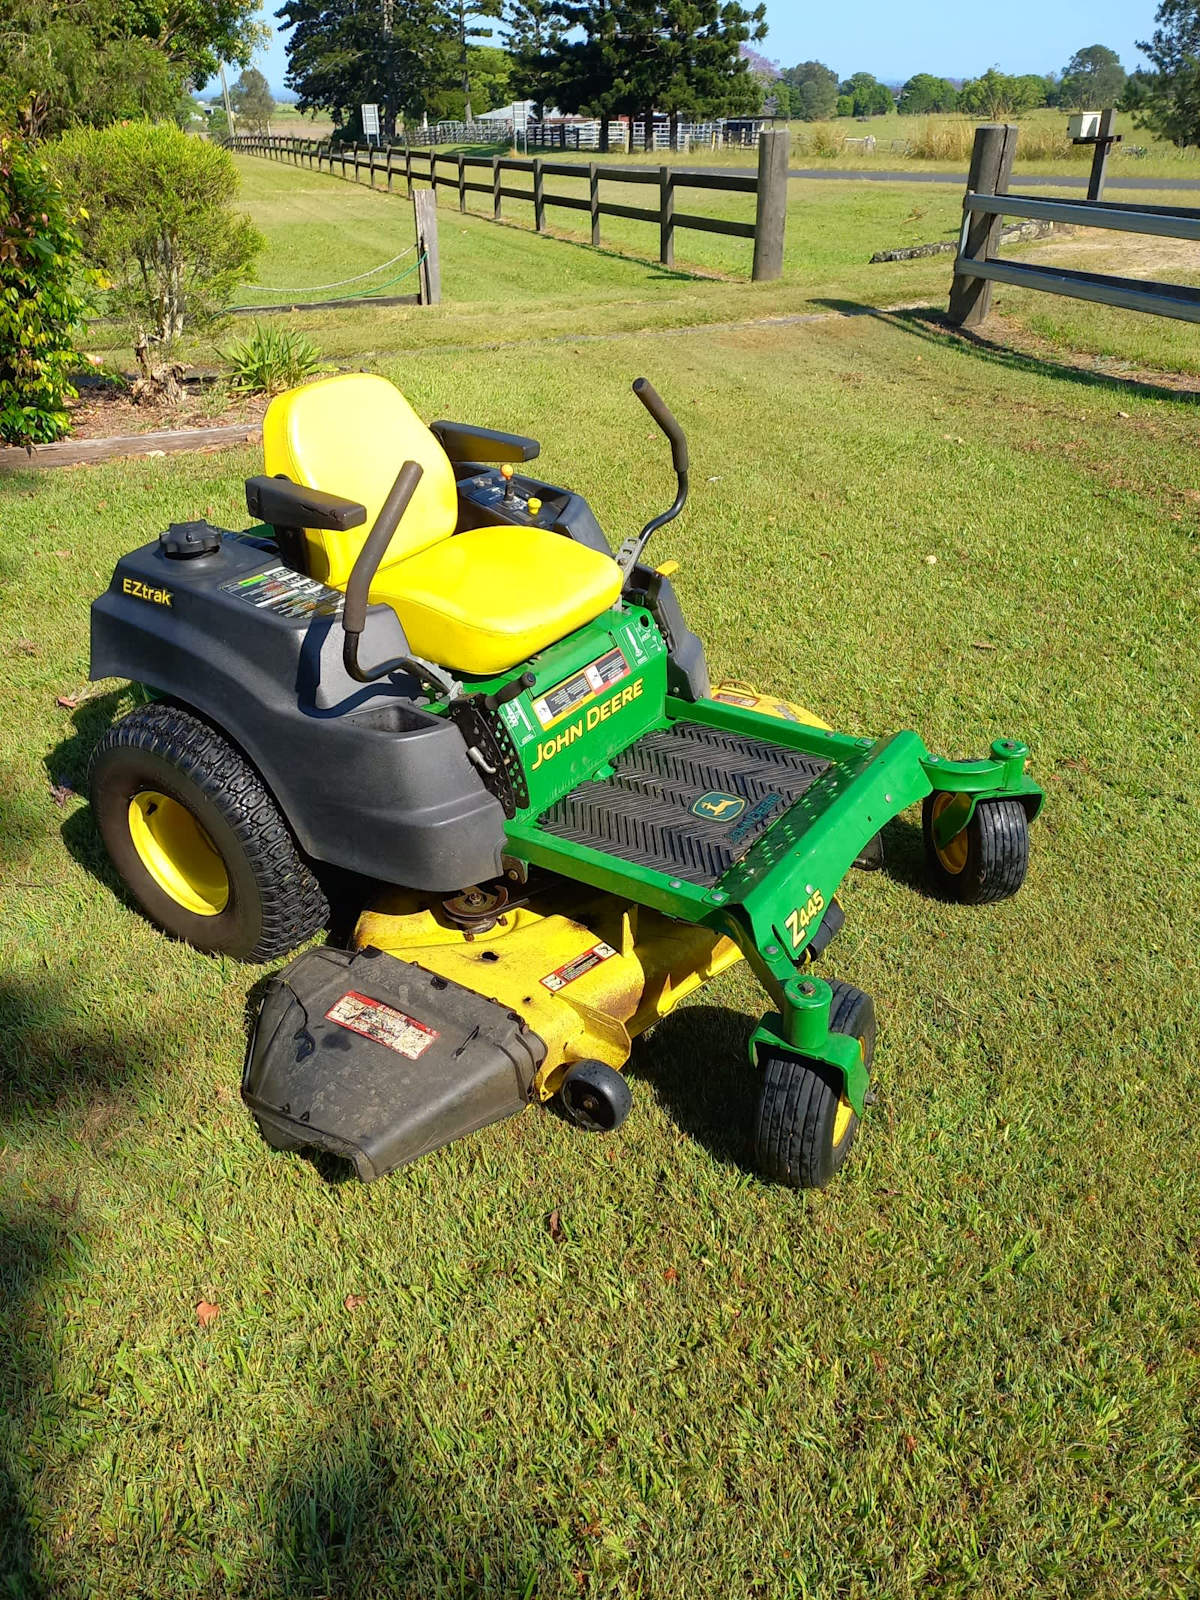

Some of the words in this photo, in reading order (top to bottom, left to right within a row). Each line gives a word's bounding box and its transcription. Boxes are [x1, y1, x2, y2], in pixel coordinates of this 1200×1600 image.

[122, 578, 172, 606] EZtrak
[531, 720, 583, 770] JOHN
[586, 678, 644, 731] DEERE
[785, 889, 825, 948] Z445
